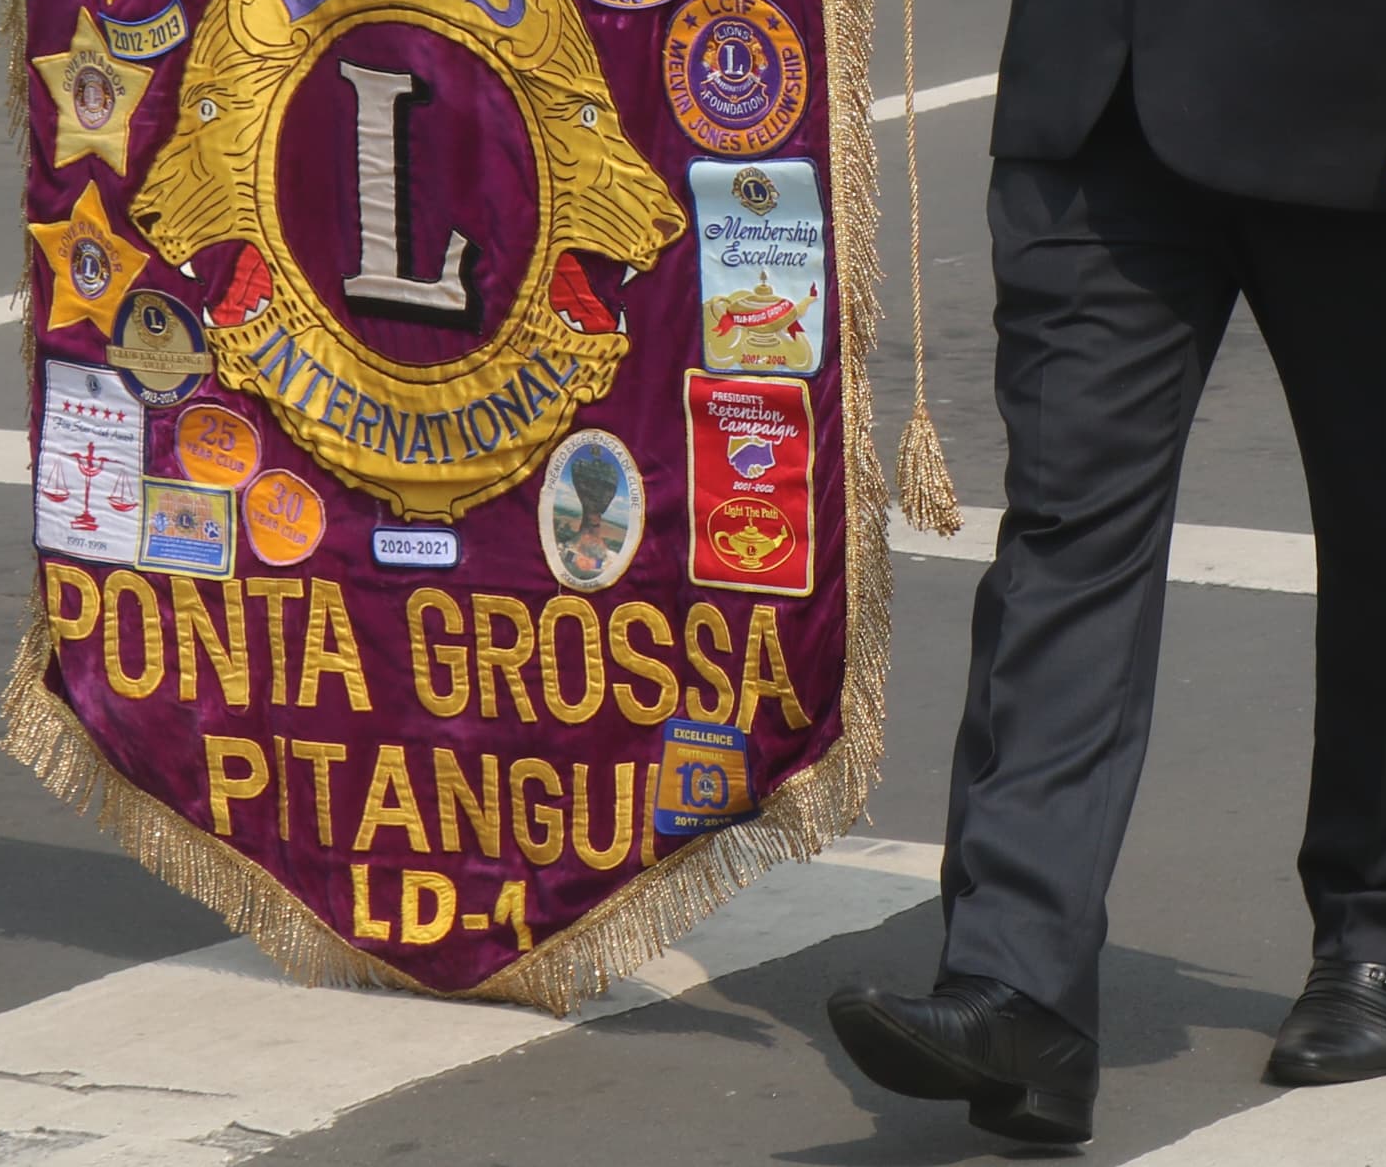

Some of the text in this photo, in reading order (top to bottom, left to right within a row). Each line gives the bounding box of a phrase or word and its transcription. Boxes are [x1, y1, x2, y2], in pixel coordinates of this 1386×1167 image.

[113, 15, 182, 52] 2012-2013
[717, 25, 751, 41] LIONS
[63, 50, 126, 98] GOVERNADOR
[724, 43, 745, 76] L
[669, 37, 803, 153] MELVIN JONES FELLOWSHIP
[703, 86, 764, 116] FOUNDATION
[339, 60, 477, 324] L
[748, 185, 763, 202] L
[58, 221, 123, 273] GOVERNADOR
[705, 216, 818, 248] Membership
[85, 259, 97, 280] L
[721, 240, 808, 267] Excellence
[147, 308, 164, 331] L
[249, 327, 582, 465] INTERNATIONAL
[707, 400, 785, 423] Retention
[712, 390, 765, 405] PRESIDENT'S
[199, 415, 238, 452] 25
[718, 415, 799, 445] Campaign
[184, 441, 246, 473] YEAR CLUB
[547, 431, 642, 511] PRÊMIO EXCELÊNCIA DE CLUBE
[268, 482, 305, 524] 30
[723, 504, 779, 520] Light The Path
[252, 510, 309, 545] YEAR CLUB
[380, 539, 450, 556] 2020-2021
[46, 562, 813, 733] PONTA GROSSA
[673, 727, 734, 747] EXCELLENCE
[677, 747, 725, 762] CENTENNIAL
[205, 732, 661, 871] PITANGUI
[675, 761, 730, 810] 100
[350, 862, 536, 952] LD-1
